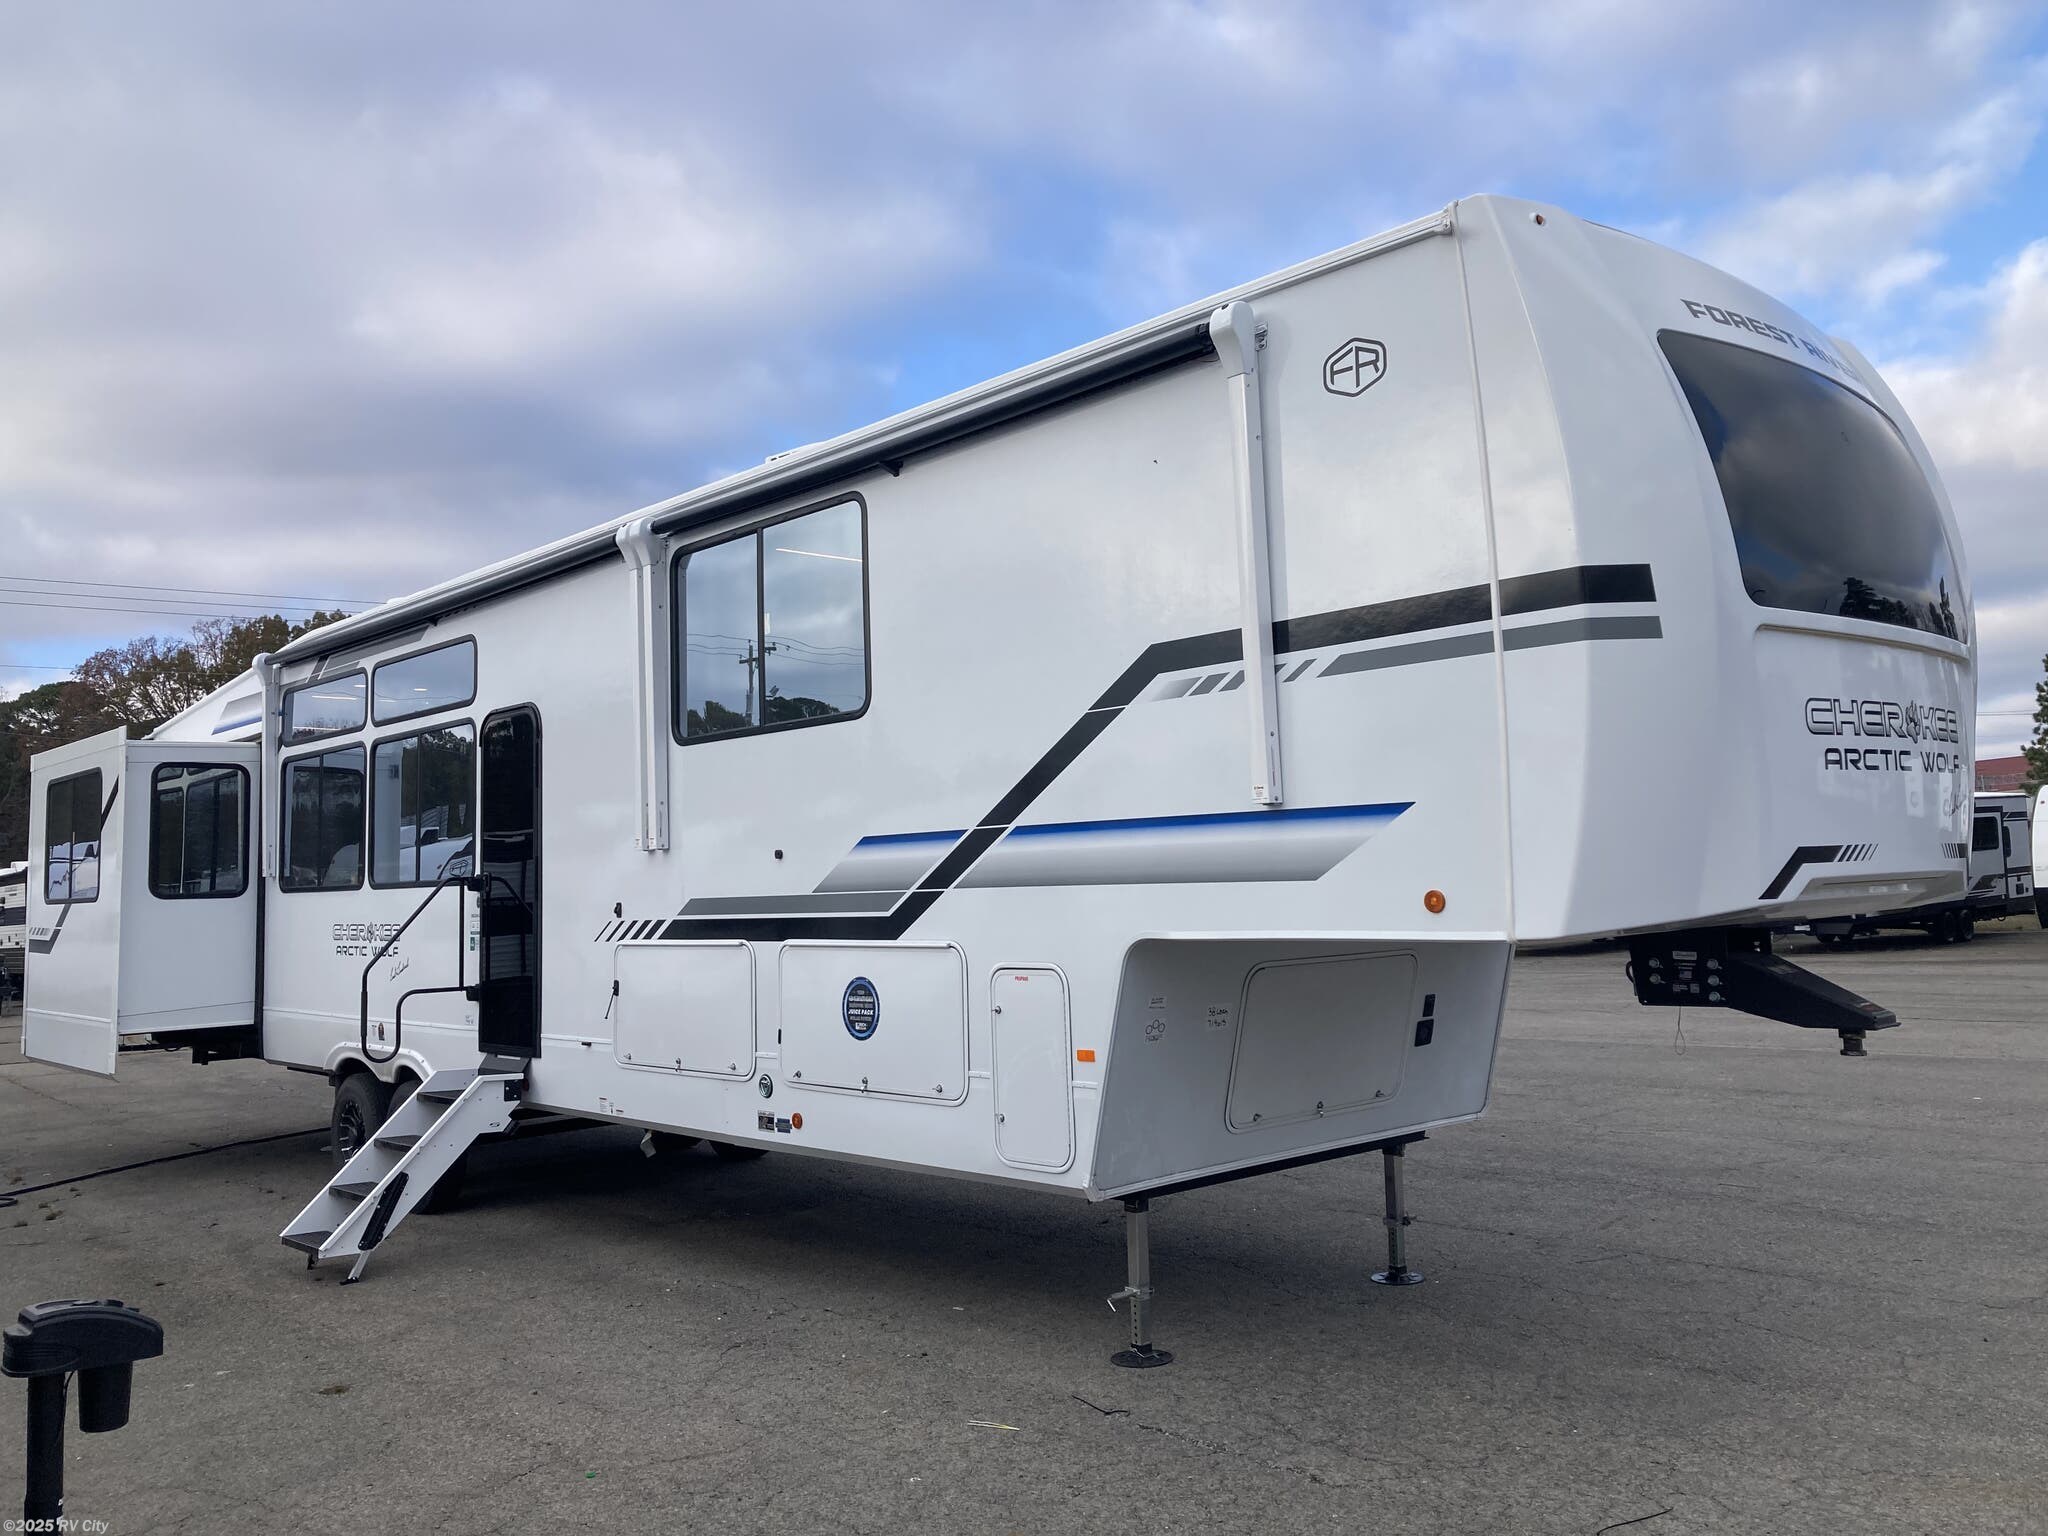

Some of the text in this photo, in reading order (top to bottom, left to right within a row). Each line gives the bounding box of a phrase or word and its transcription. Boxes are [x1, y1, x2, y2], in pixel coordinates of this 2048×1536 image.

[1680, 298, 1799, 348] FOREST
[1825, 748, 1959, 774] ARCTIC WOLF
[336, 945, 367, 957] ARCTIC
[861, 1008, 874, 1016] PACK
